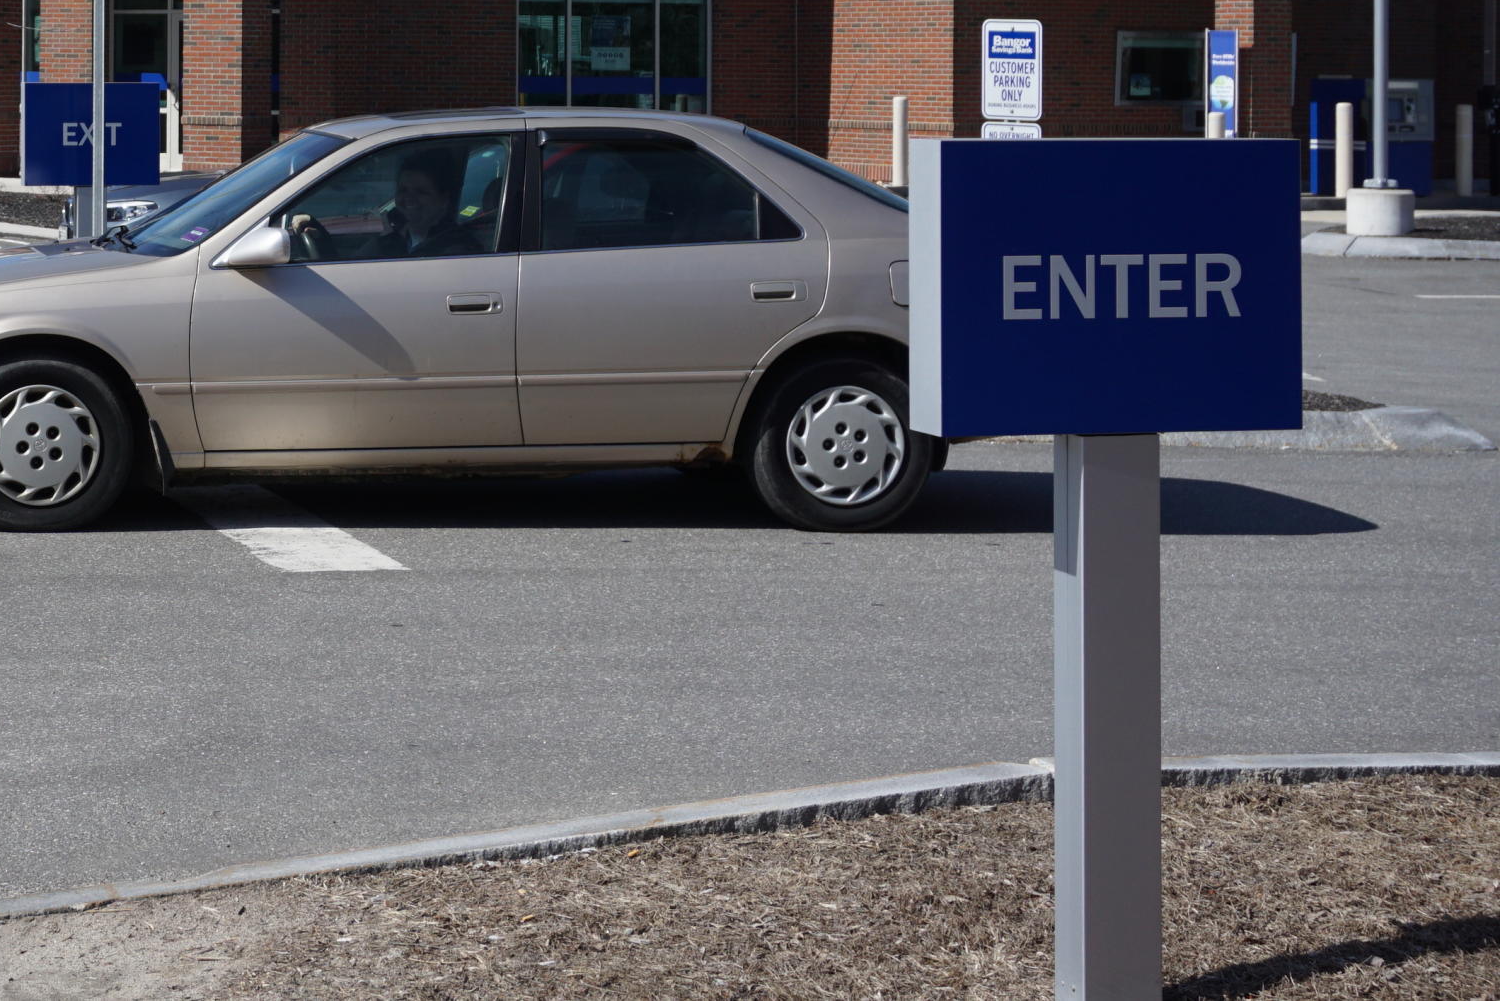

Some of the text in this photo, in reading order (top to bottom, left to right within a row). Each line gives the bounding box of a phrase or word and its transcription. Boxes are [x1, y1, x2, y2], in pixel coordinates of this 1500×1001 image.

[992, 35, 1032, 50] Bangor
[989, 61, 1035, 74] CUSTOMER
[993, 75, 1031, 88] PARKING
[1001, 89, 1023, 101] ONLY
[62, 121, 123, 146] EXT
[1002, 253, 1242, 320] ENTER
